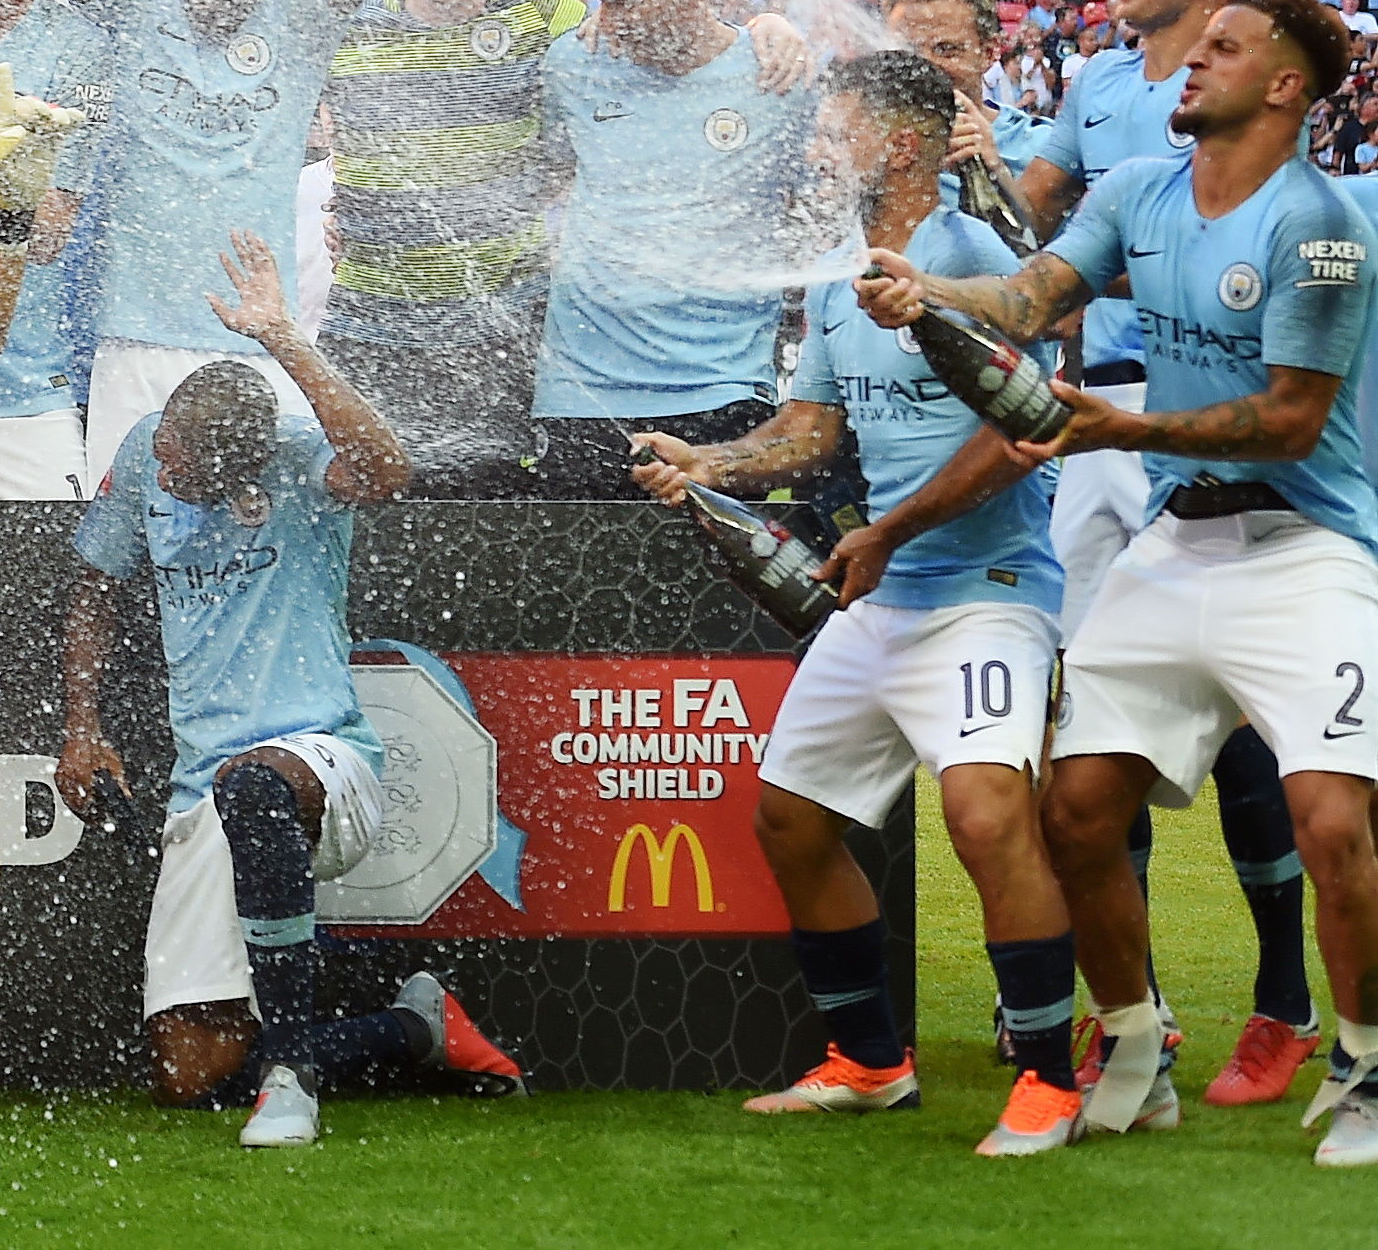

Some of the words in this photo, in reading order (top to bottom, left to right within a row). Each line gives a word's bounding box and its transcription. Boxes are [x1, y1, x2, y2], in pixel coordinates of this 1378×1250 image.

[1297, 240, 1366, 263] NEXEN
[1310, 259, 1357, 282] TIRE
[155, 546, 278, 590] TIHAD
[571, 689, 662, 727] THE
[673, 679, 751, 727] FA
[960, 659, 1014, 719] 10
[1334, 661, 1365, 727] 2
[551, 732, 773, 765] COMMUNITY
[598, 768, 725, 800] SHIELD
